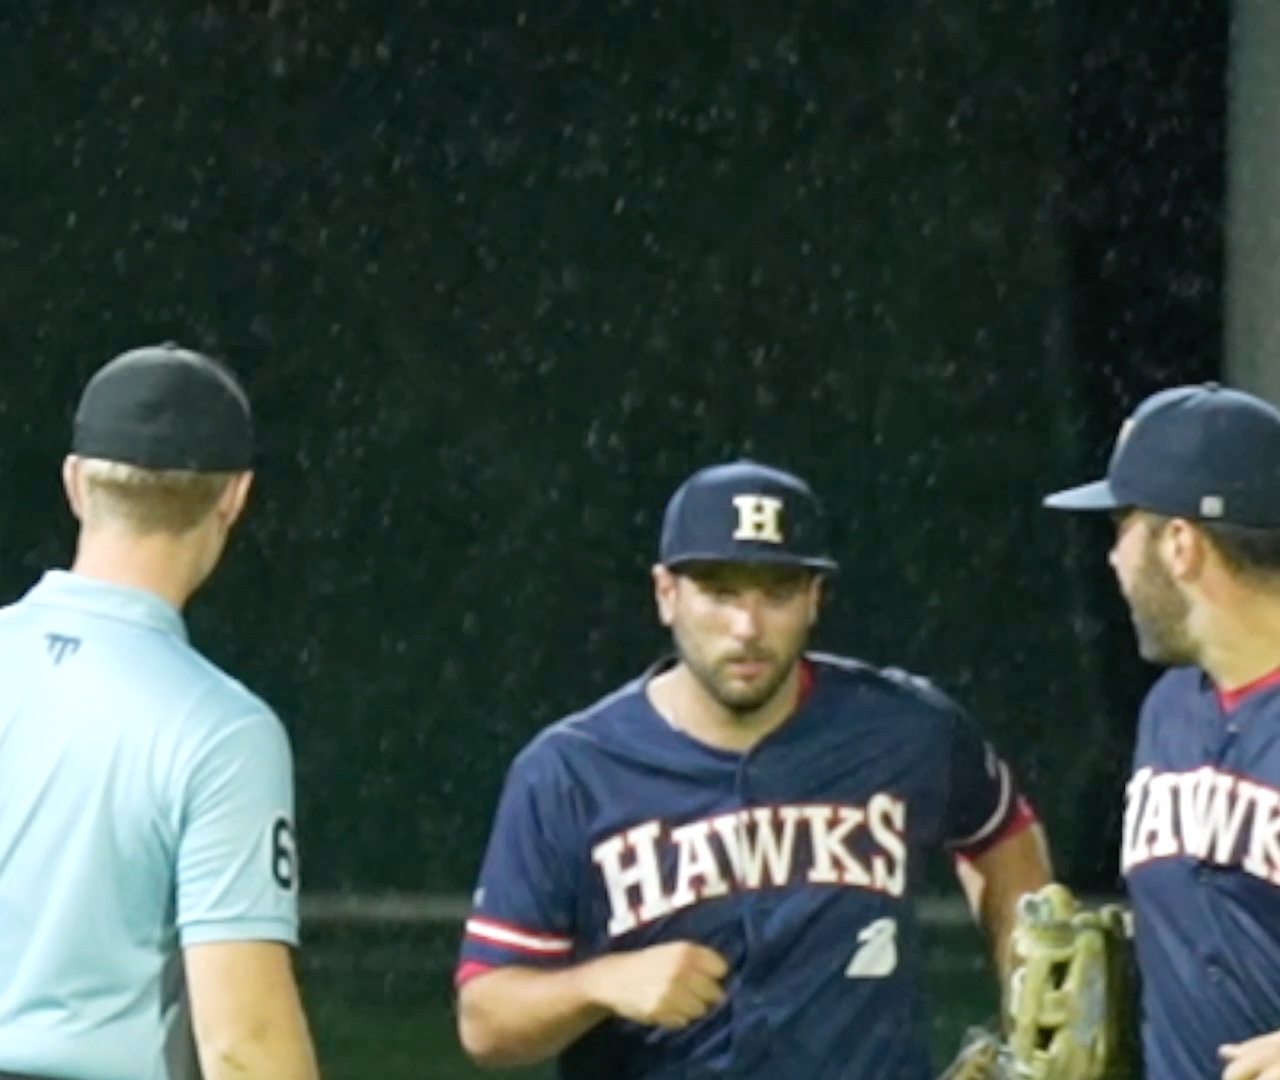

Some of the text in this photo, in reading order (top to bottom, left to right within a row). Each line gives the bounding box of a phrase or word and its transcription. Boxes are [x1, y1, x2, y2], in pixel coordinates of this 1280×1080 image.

[732, 494, 783, 544] H
[272, 817, 297, 891] 6
[592, 792, 907, 938] HAWKS
